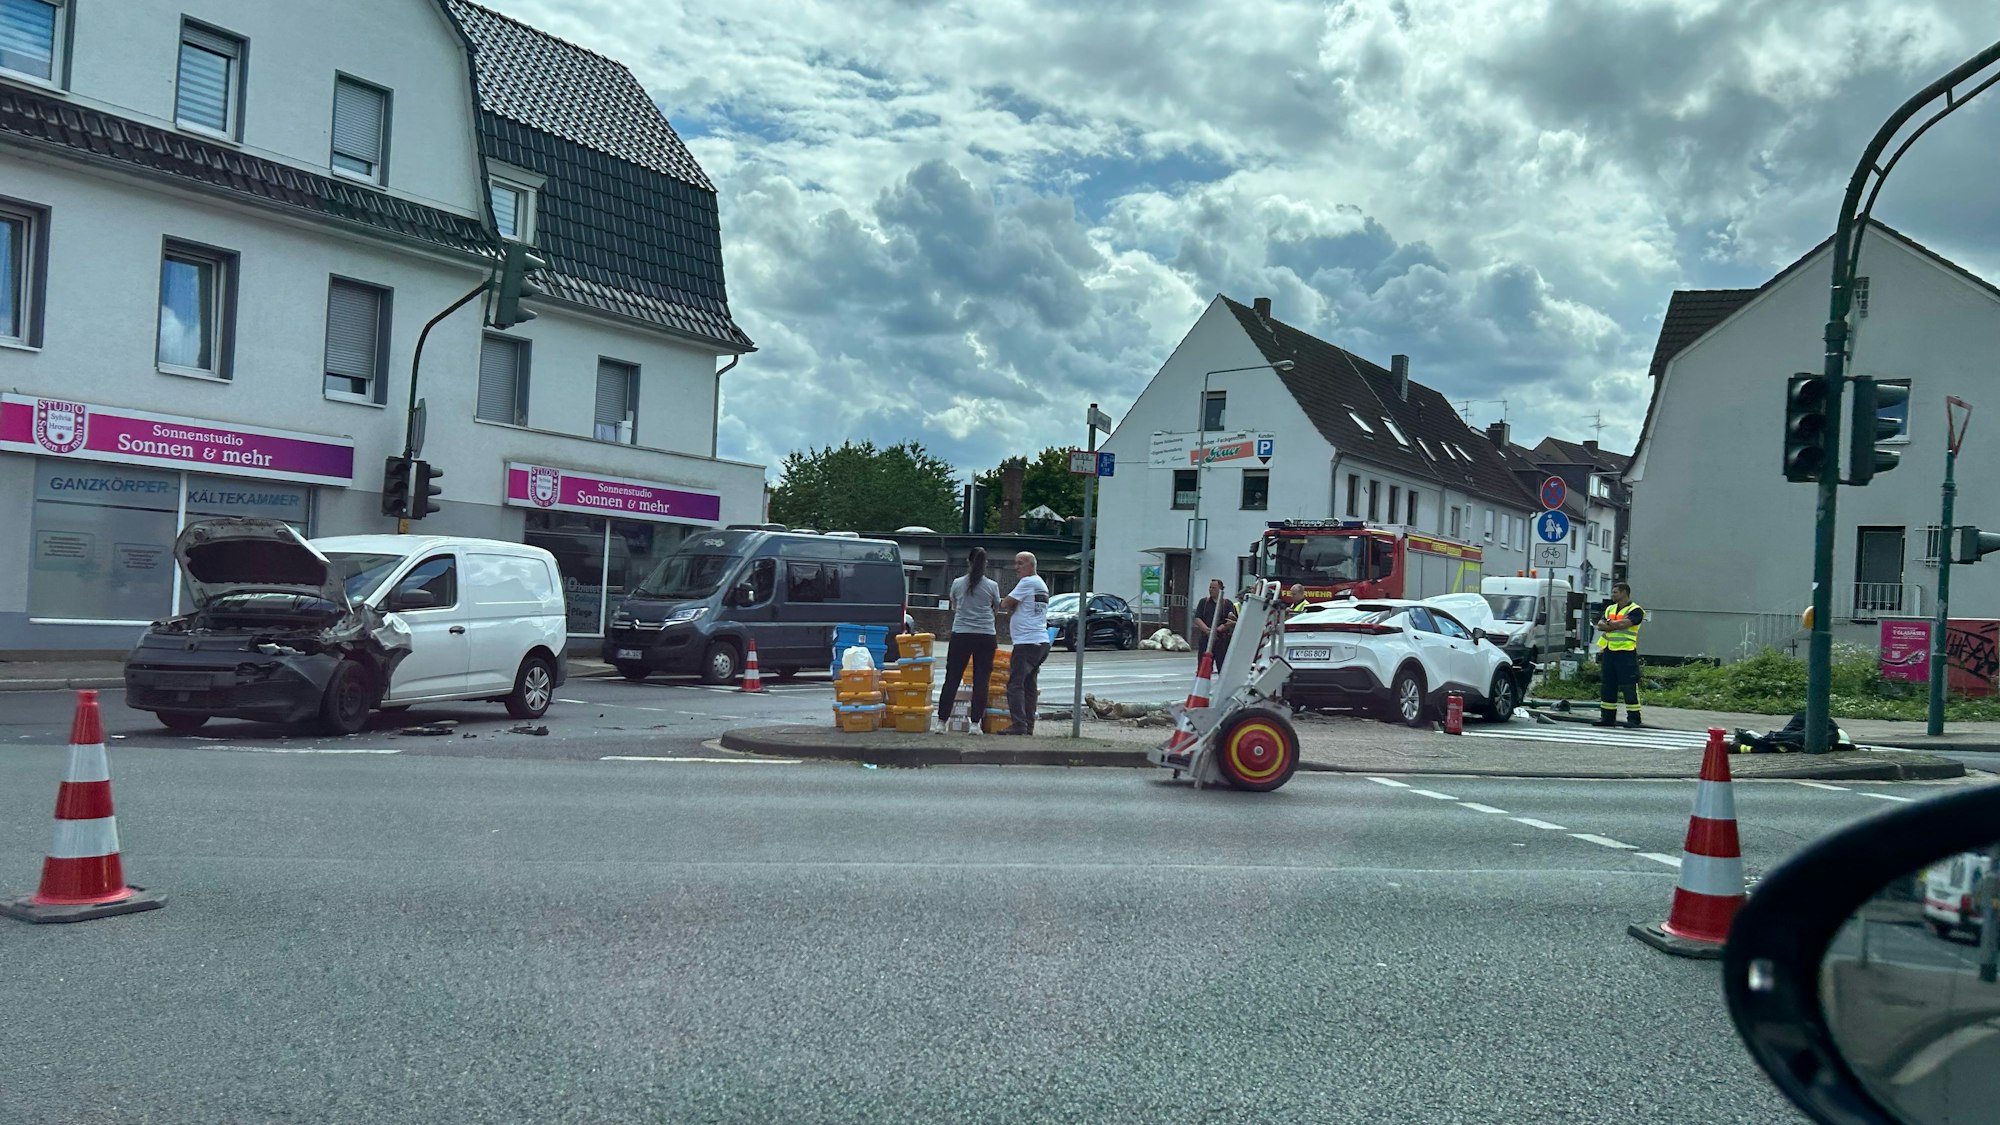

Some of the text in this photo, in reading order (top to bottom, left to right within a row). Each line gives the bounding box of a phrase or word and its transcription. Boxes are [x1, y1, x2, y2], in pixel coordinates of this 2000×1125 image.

[39, 400, 84, 414] STUDIO
[37, 420, 58, 451] Sonnen
[70, 424, 84, 449] mehr
[152, 424, 244, 446] Sonnenstudio
[118, 433, 273, 467] Sonnen & mehr
[187, 490, 299, 506] KÄLTEKAMMER
[597, 482, 653, 498] Sonnenstudio
[577, 490, 670, 513] Sonnen & mehr
[1281, 590, 1333, 598] FERWEHR
